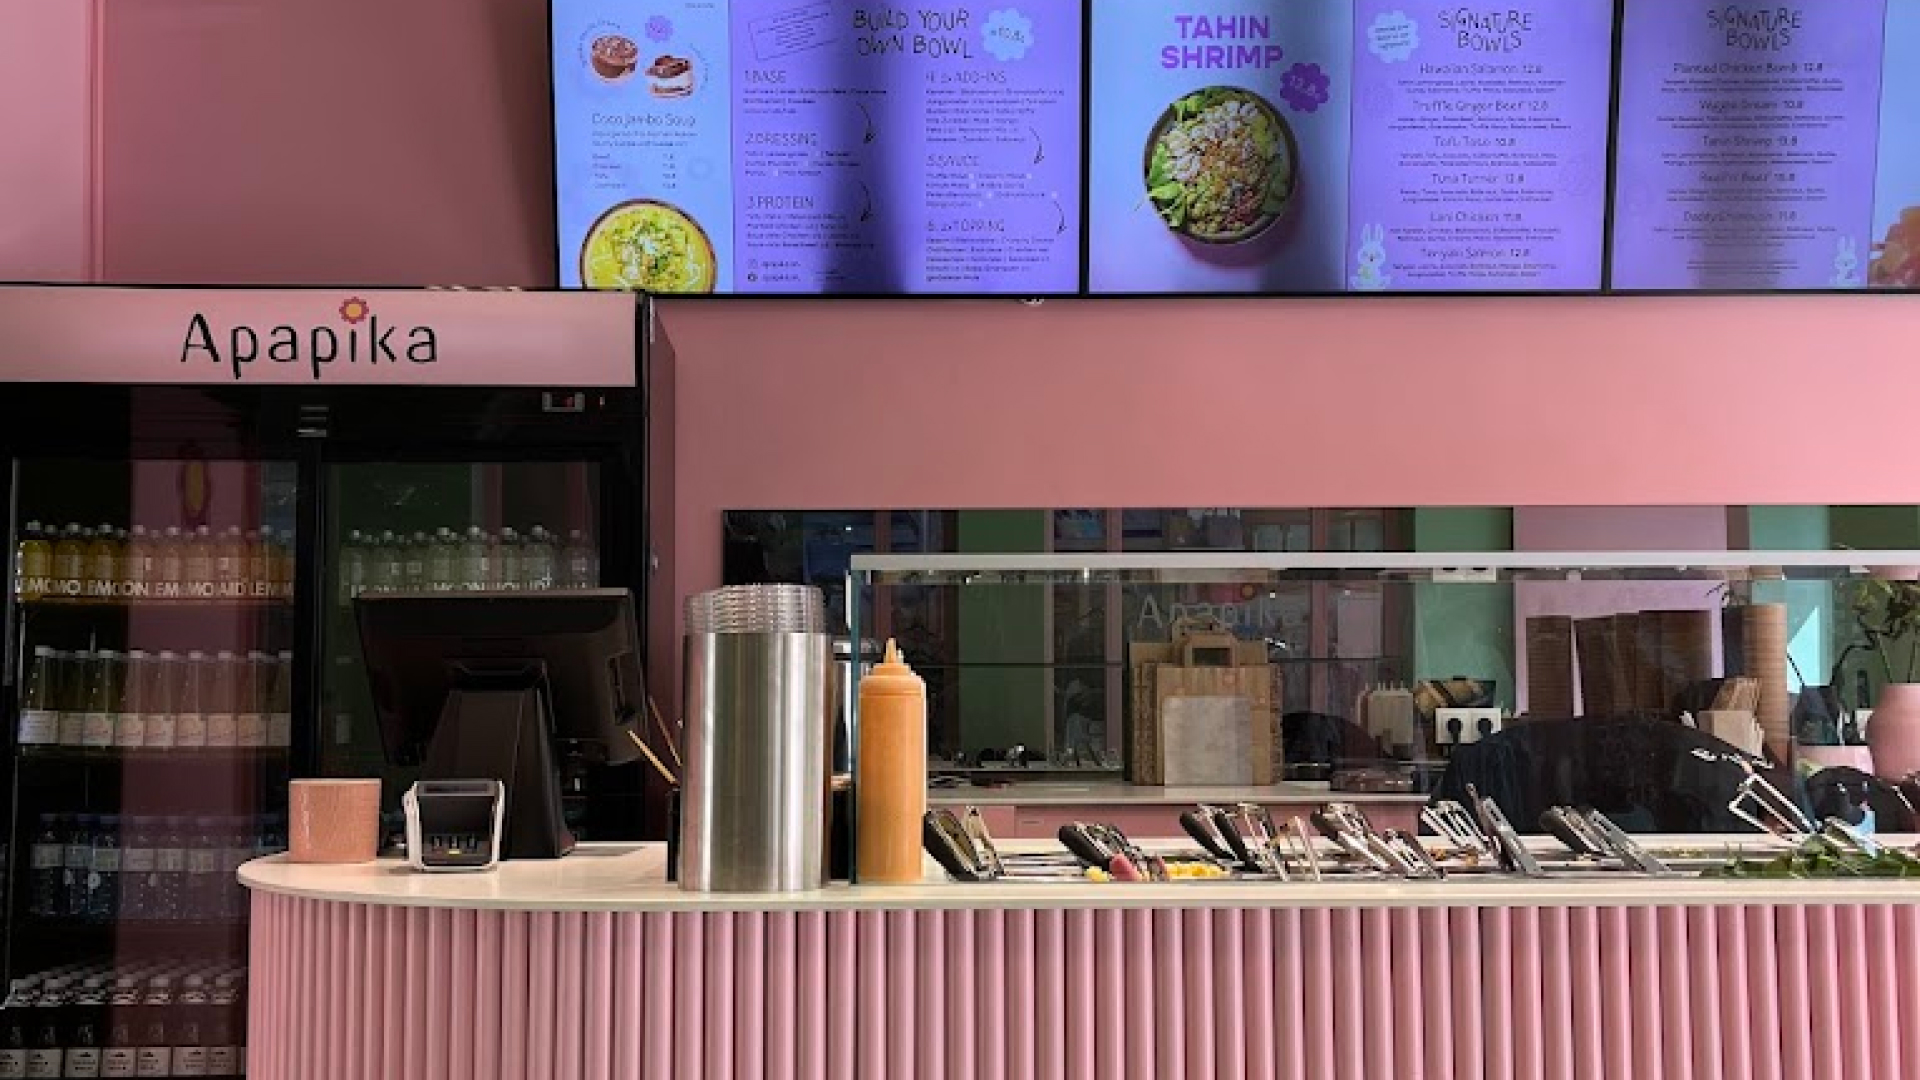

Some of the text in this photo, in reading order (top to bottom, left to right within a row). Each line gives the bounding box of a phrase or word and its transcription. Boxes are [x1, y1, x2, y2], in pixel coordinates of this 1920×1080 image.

[853, 9, 909, 31] BUILD
[919, 8, 971, 31] YOUR
[1175, 15, 1270, 38] TAHIN
[1438, 8, 1532, 33] SIGNATURE
[1707, 6, 1802, 31] SIGNATURE
[856, 34, 973, 59] OWN BOWL
[1457, 30, 1522, 53] BOWLS
[1726, 28, 1791, 51] BOWLS
[1161, 45, 1283, 69] SHRIMP
[181, 298, 438, 379] Apapika
